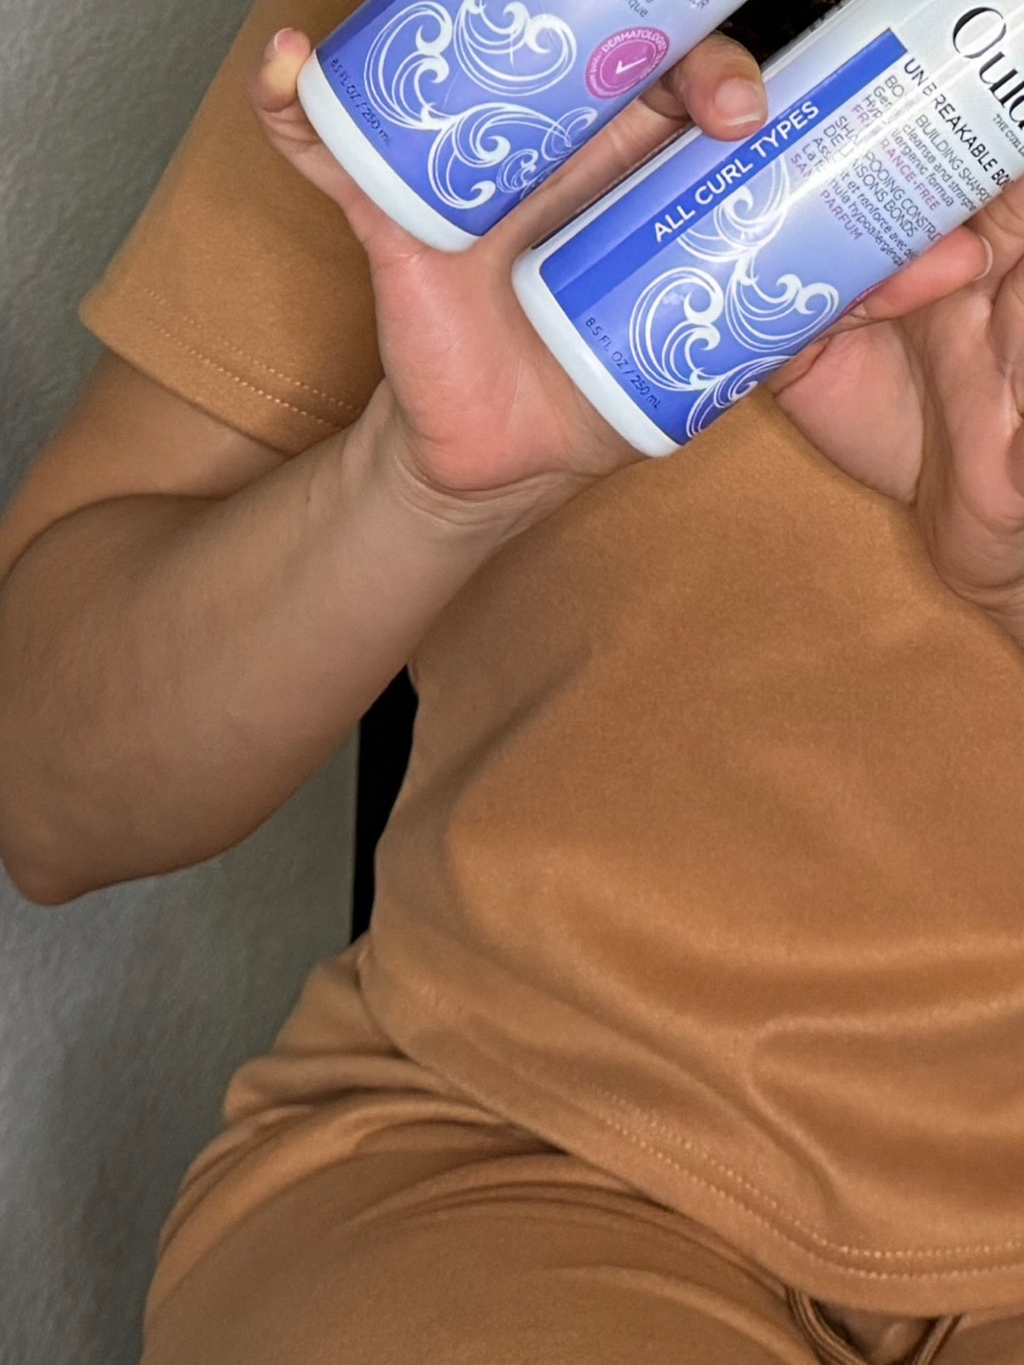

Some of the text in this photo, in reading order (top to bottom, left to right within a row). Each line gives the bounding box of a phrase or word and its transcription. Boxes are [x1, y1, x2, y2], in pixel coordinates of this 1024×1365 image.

[360, 107, 381, 130] 250
[903, 57, 998, 173] UNBREAKABLE
[801, 143, 816, 161] La
[914, 113, 964, 171] BUILDING
[655, 101, 818, 242] ALL CURL TYPES
[821, 123, 842, 145] DE
[883, 198, 918, 238] BONDS
[932, 162, 952, 183] and
[818, 189, 863, 239] PARFUM
[846, 180, 860, 194] et
[856, 193, 892, 234] renforce
[609, 349, 628, 369] OZ
[630, 373, 651, 396] 250
